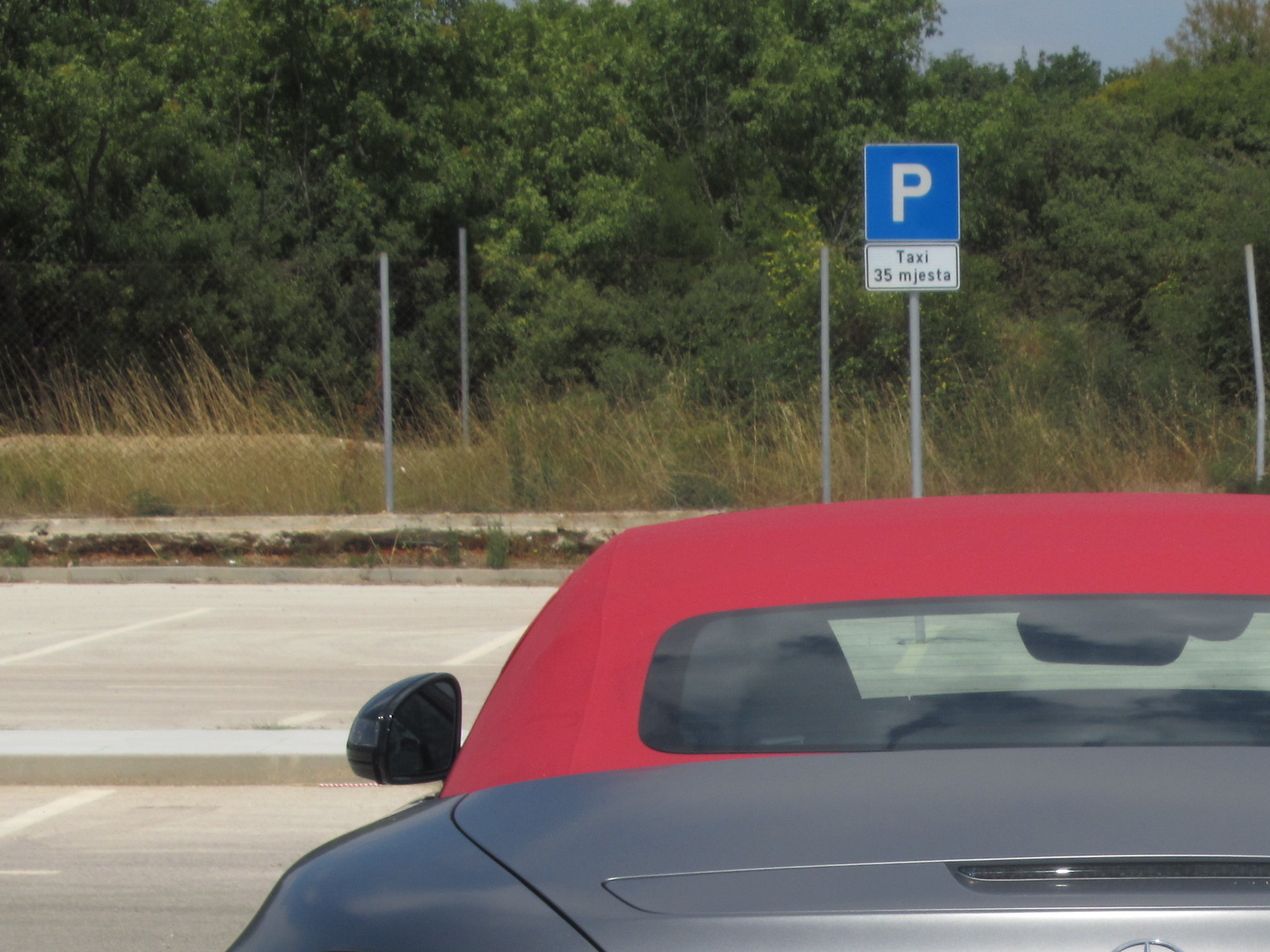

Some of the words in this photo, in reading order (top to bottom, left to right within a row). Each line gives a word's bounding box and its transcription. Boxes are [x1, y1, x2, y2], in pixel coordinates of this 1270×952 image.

[892, 163, 932, 222] P
[896, 249, 929, 264] Taxi
[873, 268, 893, 282] 35
[899, 268, 952, 285] mjesta
